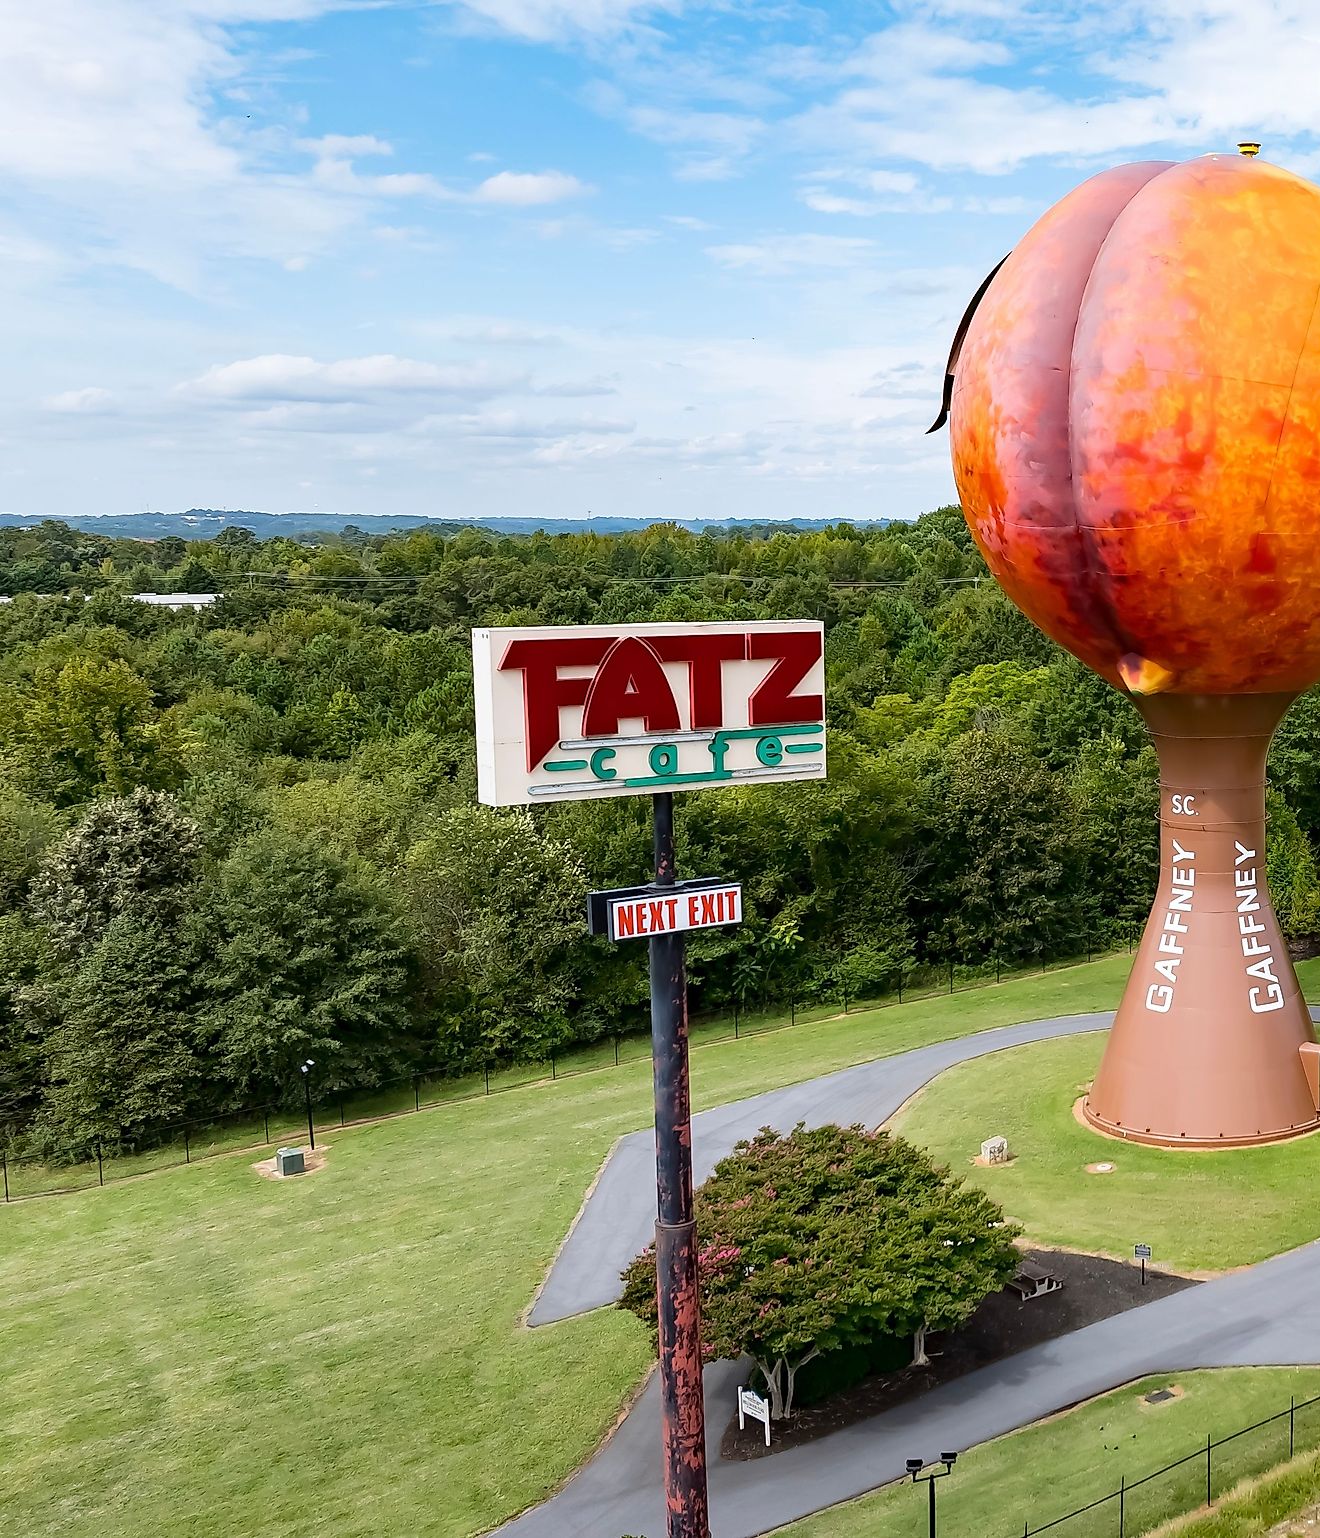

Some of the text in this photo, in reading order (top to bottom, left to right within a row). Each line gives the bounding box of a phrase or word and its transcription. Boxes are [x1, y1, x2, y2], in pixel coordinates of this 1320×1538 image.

[497, 632, 823, 773] FATZ
[589, 734, 783, 780] cafe
[617, 890, 738, 937] NEXT EXIT
[1145, 839, 1196, 1013] GAFFNEY
[1234, 840, 1284, 1014] GAFFNEY
